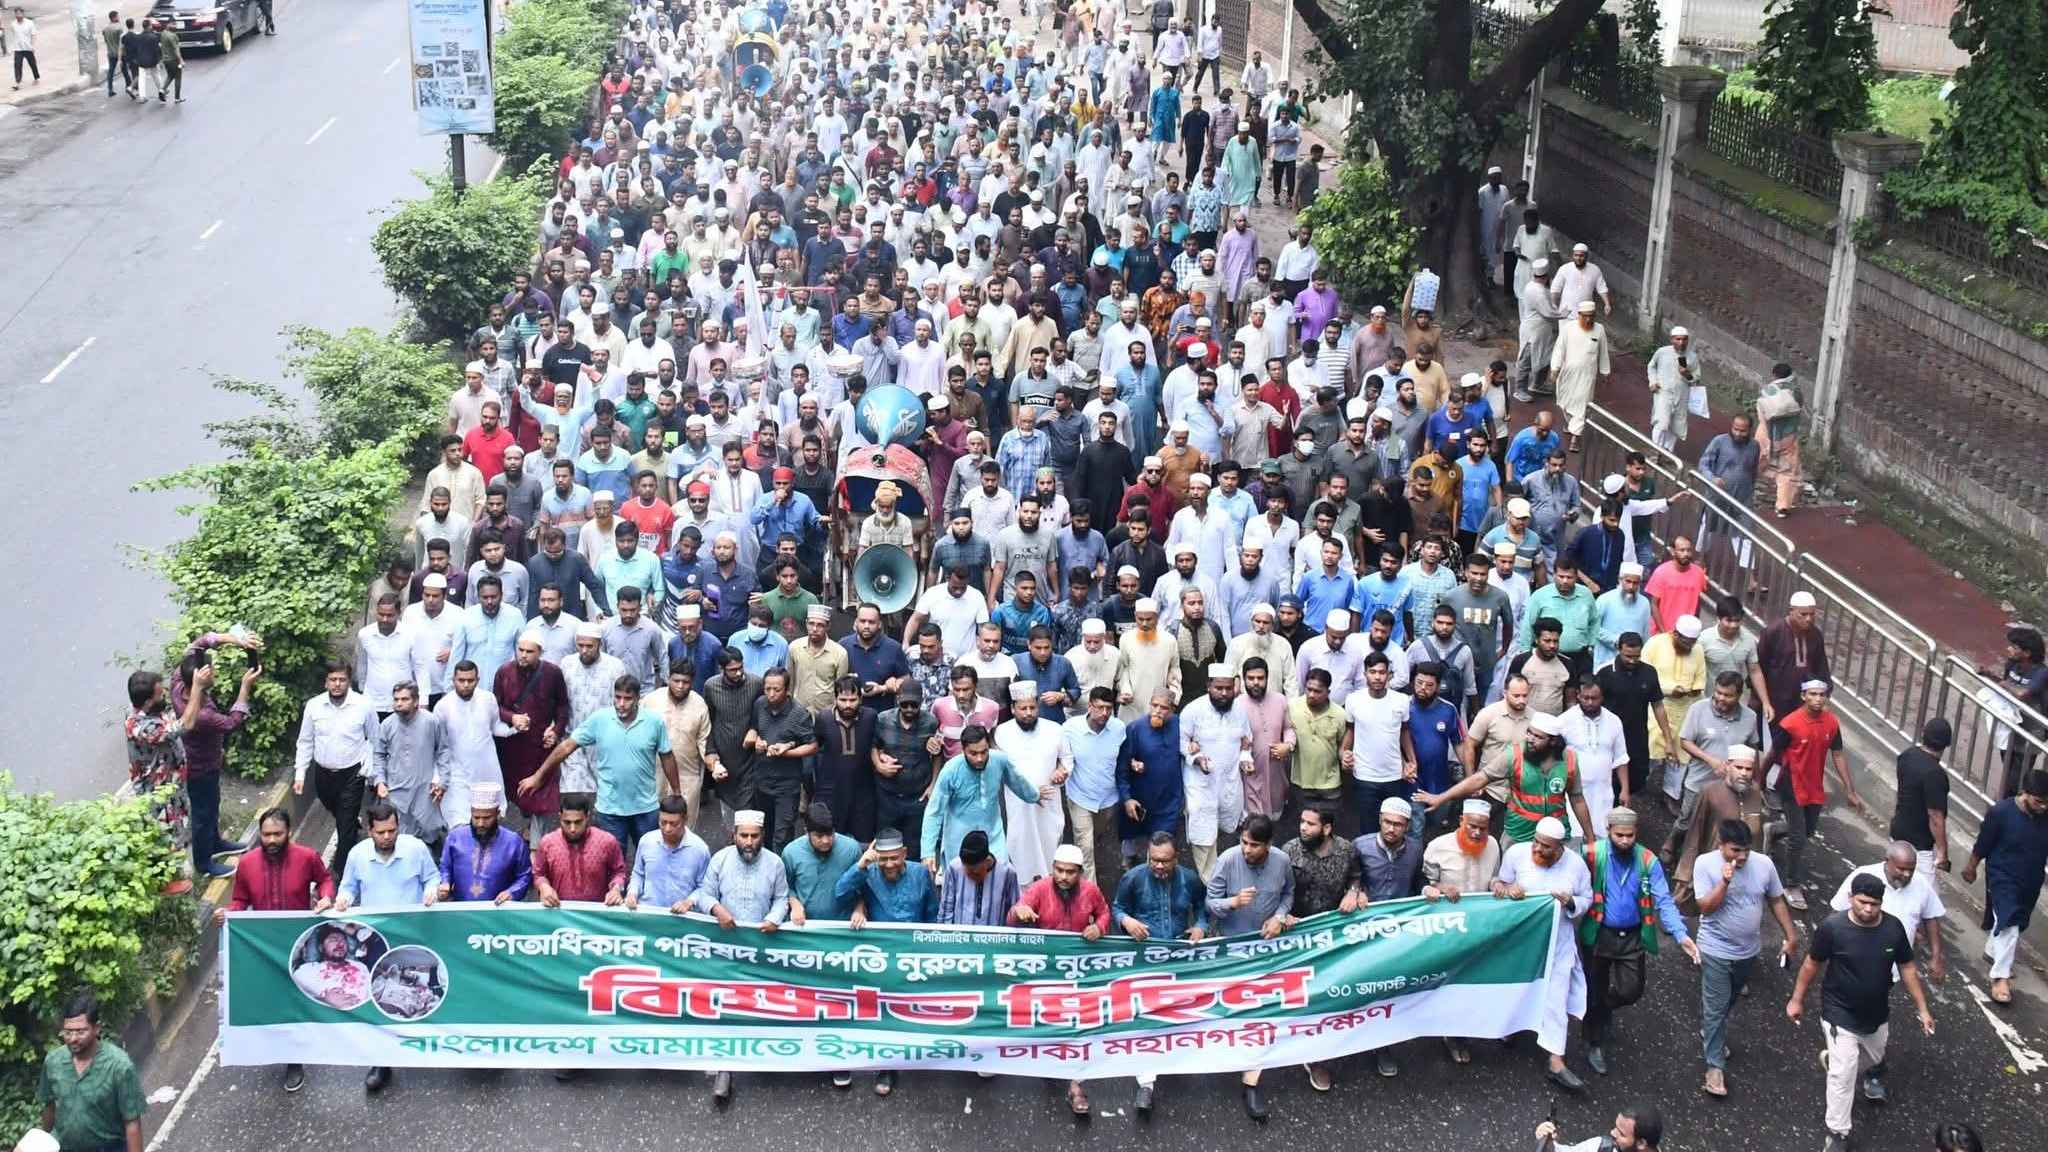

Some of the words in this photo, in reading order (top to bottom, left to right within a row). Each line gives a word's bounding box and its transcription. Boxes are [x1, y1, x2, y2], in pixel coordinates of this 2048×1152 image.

[467, 927, 647, 956] গণঅধিকার
[654, 933, 758, 963] পরিষদ
[764, 944, 888, 973] সভাপতি
[896, 952, 985, 982] নুরুল
[993, 953, 1047, 977] হক
[1056, 951, 1137, 980] নুরের
[1144, 945, 1219, 963] উপর
[1342, 911, 1468, 945] প্রতিবাদে
[579, 964, 984, 1026] বিক্ষোভ
[997, 965, 1315, 1029] মিছিল
[1326, 984, 1352, 998] ৩০
[1355, 975, 1407, 995] আগস্ট
[397, 1034, 597, 1055] বাংলাদেশ
[608, 1036, 803, 1057] জামায়াতে
[816, 1034, 984, 1062] ইসলামী,
[997, 1042, 1091, 1062] ঢাকা
[1103, 1022, 1278, 1055] মহানগরী
[1288, 1003, 1396, 1036] দক্ষিণ
